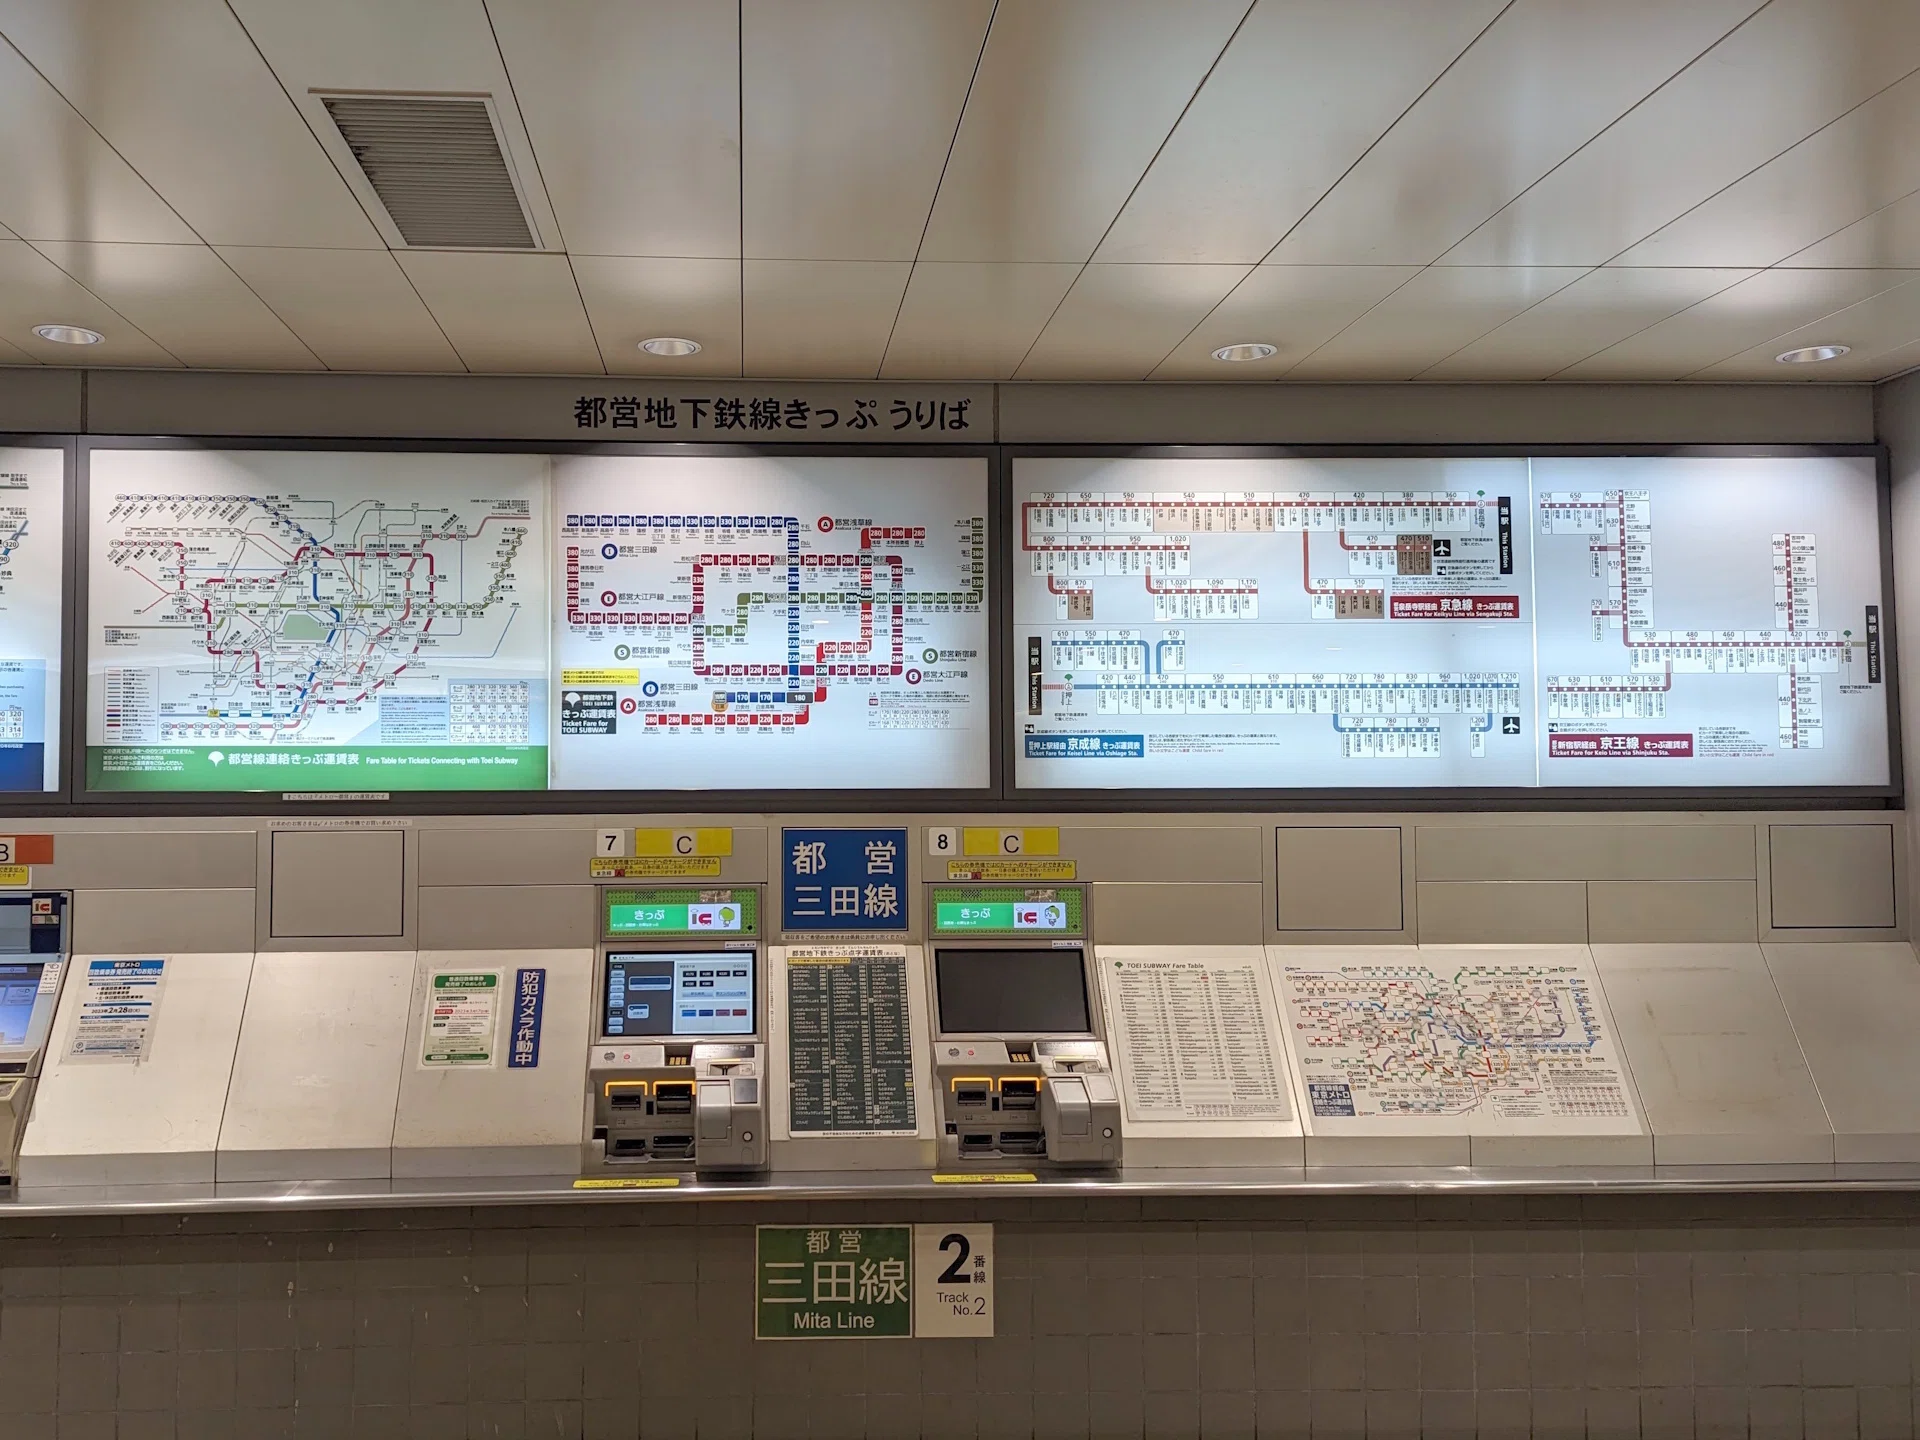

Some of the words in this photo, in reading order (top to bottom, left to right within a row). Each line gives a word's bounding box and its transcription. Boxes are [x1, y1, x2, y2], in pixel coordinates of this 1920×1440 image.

[567, 517, 579, 525] 380
[635, 517, 647, 525] 380
[686, 517, 698, 525] 330
[834, 518, 873, 527] 都営浅草線
[972, 519, 984, 527] 380
[870, 529, 882, 537] 280
[1169, 535, 1187, 543] 1,020
[1501, 531, 1509, 545] This
[567, 548, 579, 556] 380
[619, 546, 658, 554] 都営三田線
[700, 556, 713, 564] 280
[1501, 545, 1509, 569] Station
[972, 564, 984, 572] 330
[618, 593, 665, 601] 都営大江戸線
[906, 594, 918, 602] 280
[951, 594, 963, 602] 330
[1440, 598, 1473, 611] 京急線
[1476, 602, 1514, 611] きっぷ運賃表
[788, 609, 799, 617] 220
[631, 647, 671, 655] 都営新宿線
[939, 650, 978, 658] 都営新宿線
[922, 671, 969, 679] 都営大江戸線
[659, 683, 699, 691] 都営三田線
[737, 693, 749, 701] 170
[637, 700, 676, 708] 都営浅草線
[562, 709, 616, 719] きっぷ運賃表
[645, 716, 657, 724] 280
[714, 716, 726, 724] 220
[1067, 738, 1101, 750] 京成線
[1102, 741, 1141, 750] きっぷ運賃表
[1600, 737, 1640, 750] 京王線
[1643, 741, 1689, 749] きっぷ運賃表
[228, 753, 359, 765] 都営線連絡きっぷ運賃表
[365, 757, 380, 765] Fare
[380, 757, 397, 765] Table
[397, 757, 408, 765] for
[408, 757, 430, 765] Tickets
[431, 757, 466, 766] Connecting
[466, 757, 480, 765] with
[480, 757, 493, 765] Toei
[494, 757, 518, 766] Subway
[605, 835, 617, 851] 7
[676, 835, 692, 854] C
[937, 834, 948, 850] 8
[1003, 835, 1020, 853] C
[792, 883, 898, 918] 三田線
[634, 909, 665, 921] きっぷ
[960, 907, 991, 919] きっぷ
[514, 971, 540, 1065] 防犯カメラ作動中
[1311, 1091, 1350, 1099] 東京メトロ
[937, 1233, 971, 1284] 2
[973, 1255, 986, 1284] 番線
[762, 1257, 909, 1305] 三田線
[936, 1292, 969, 1303] Track
[953, 1304, 973, 1316] No.
[974, 1297, 986, 1316] 2
[793, 1312, 832, 1329] Mita
[837, 1312, 875, 1329] Line
